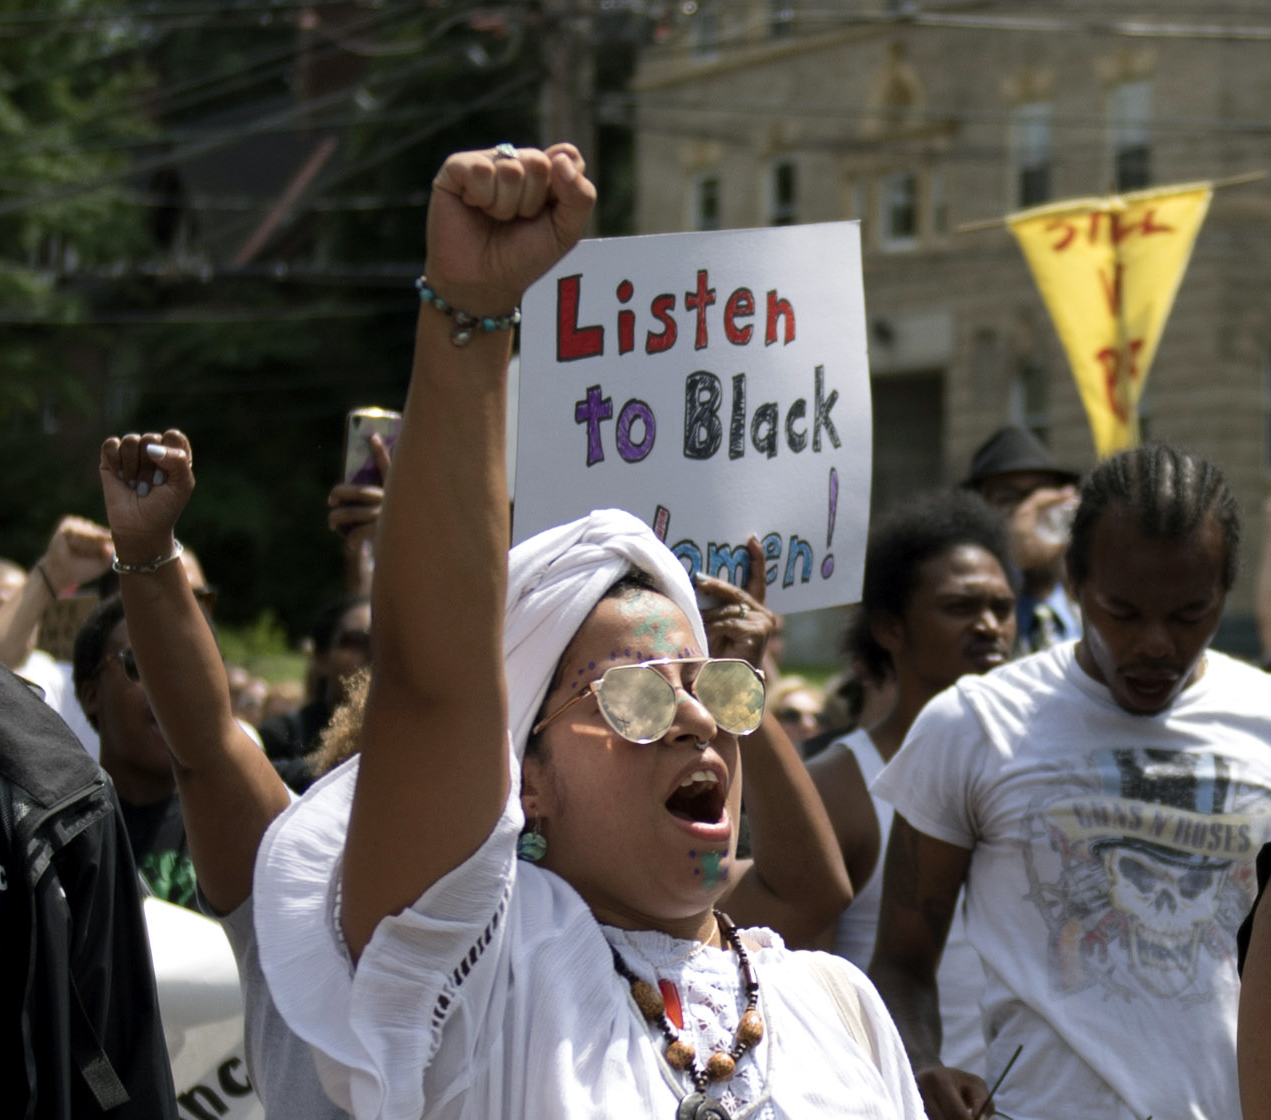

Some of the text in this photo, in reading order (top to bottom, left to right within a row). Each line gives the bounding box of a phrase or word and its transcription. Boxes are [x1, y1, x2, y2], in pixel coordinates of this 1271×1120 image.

[557, 269, 796, 362] Listen
[575, 365, 842, 467] to Black
[652, 467, 838, 590] omen!
[1173, 817, 1251, 854] ROSES
